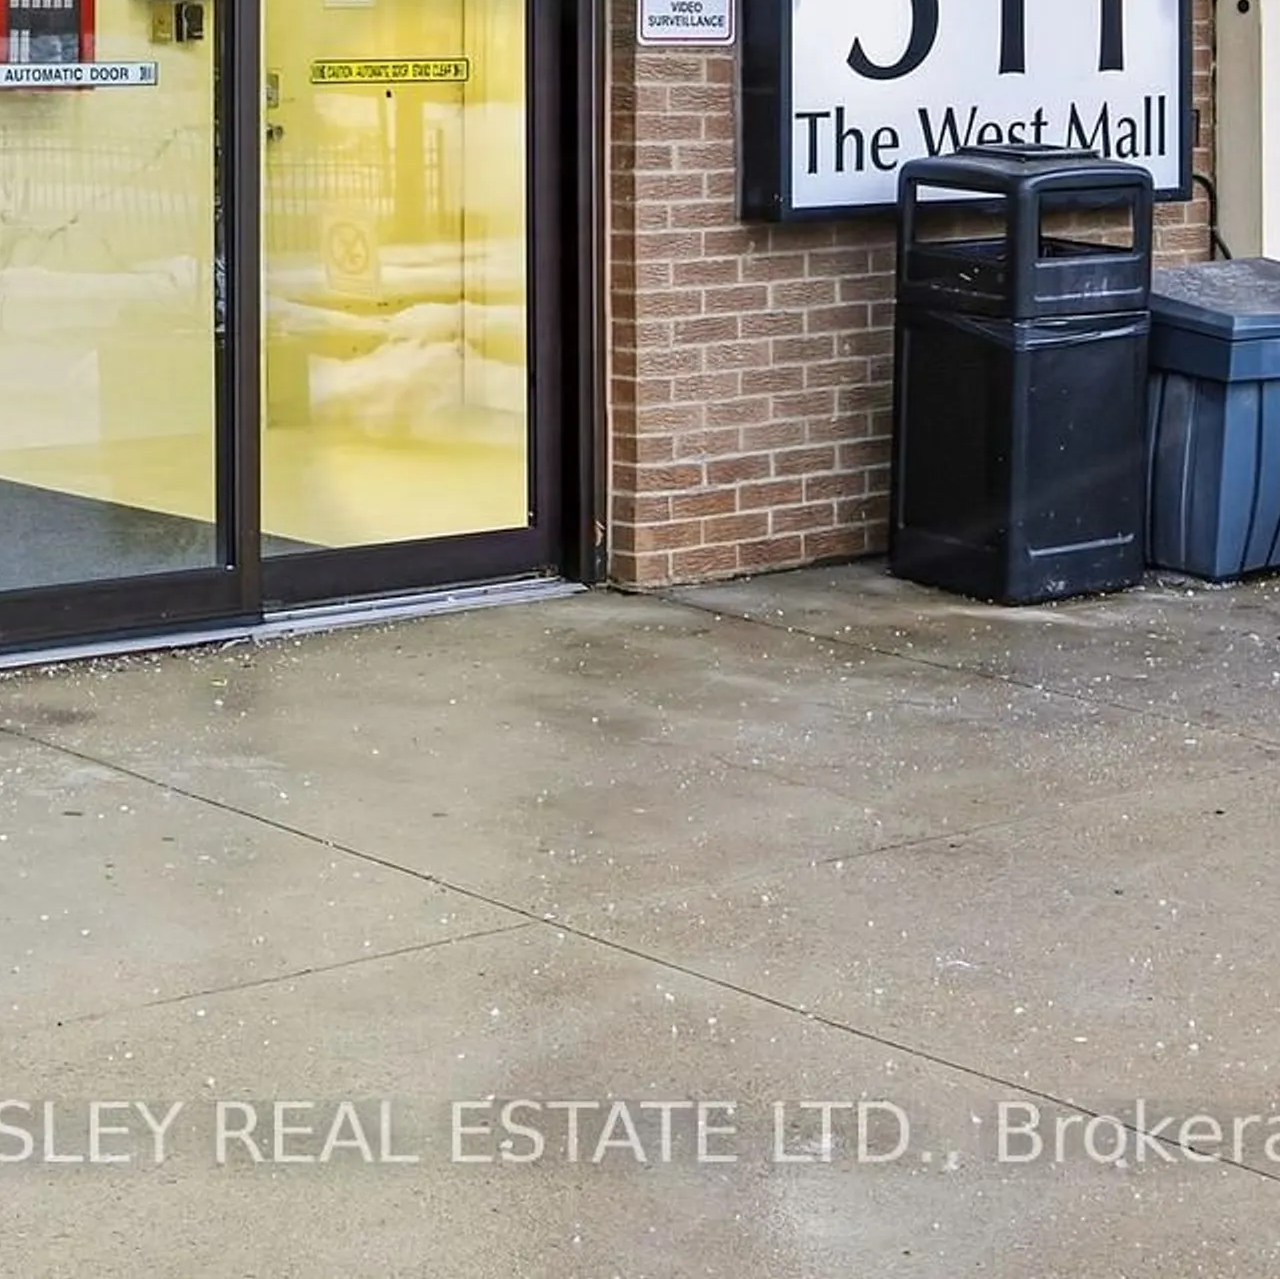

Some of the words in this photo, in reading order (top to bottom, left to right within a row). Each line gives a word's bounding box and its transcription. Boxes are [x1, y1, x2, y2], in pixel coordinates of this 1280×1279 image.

[670, 1, 704, 14] VIDEO
[647, 14, 726, 27] SURVEILLANCE
[4, 68, 83, 82] AUTOMATIC
[90, 67, 129, 81] DOOR
[794, 105, 901, 175] The
[917, 106, 1049, 158] West
[1066, 95, 1166, 159] Mall
